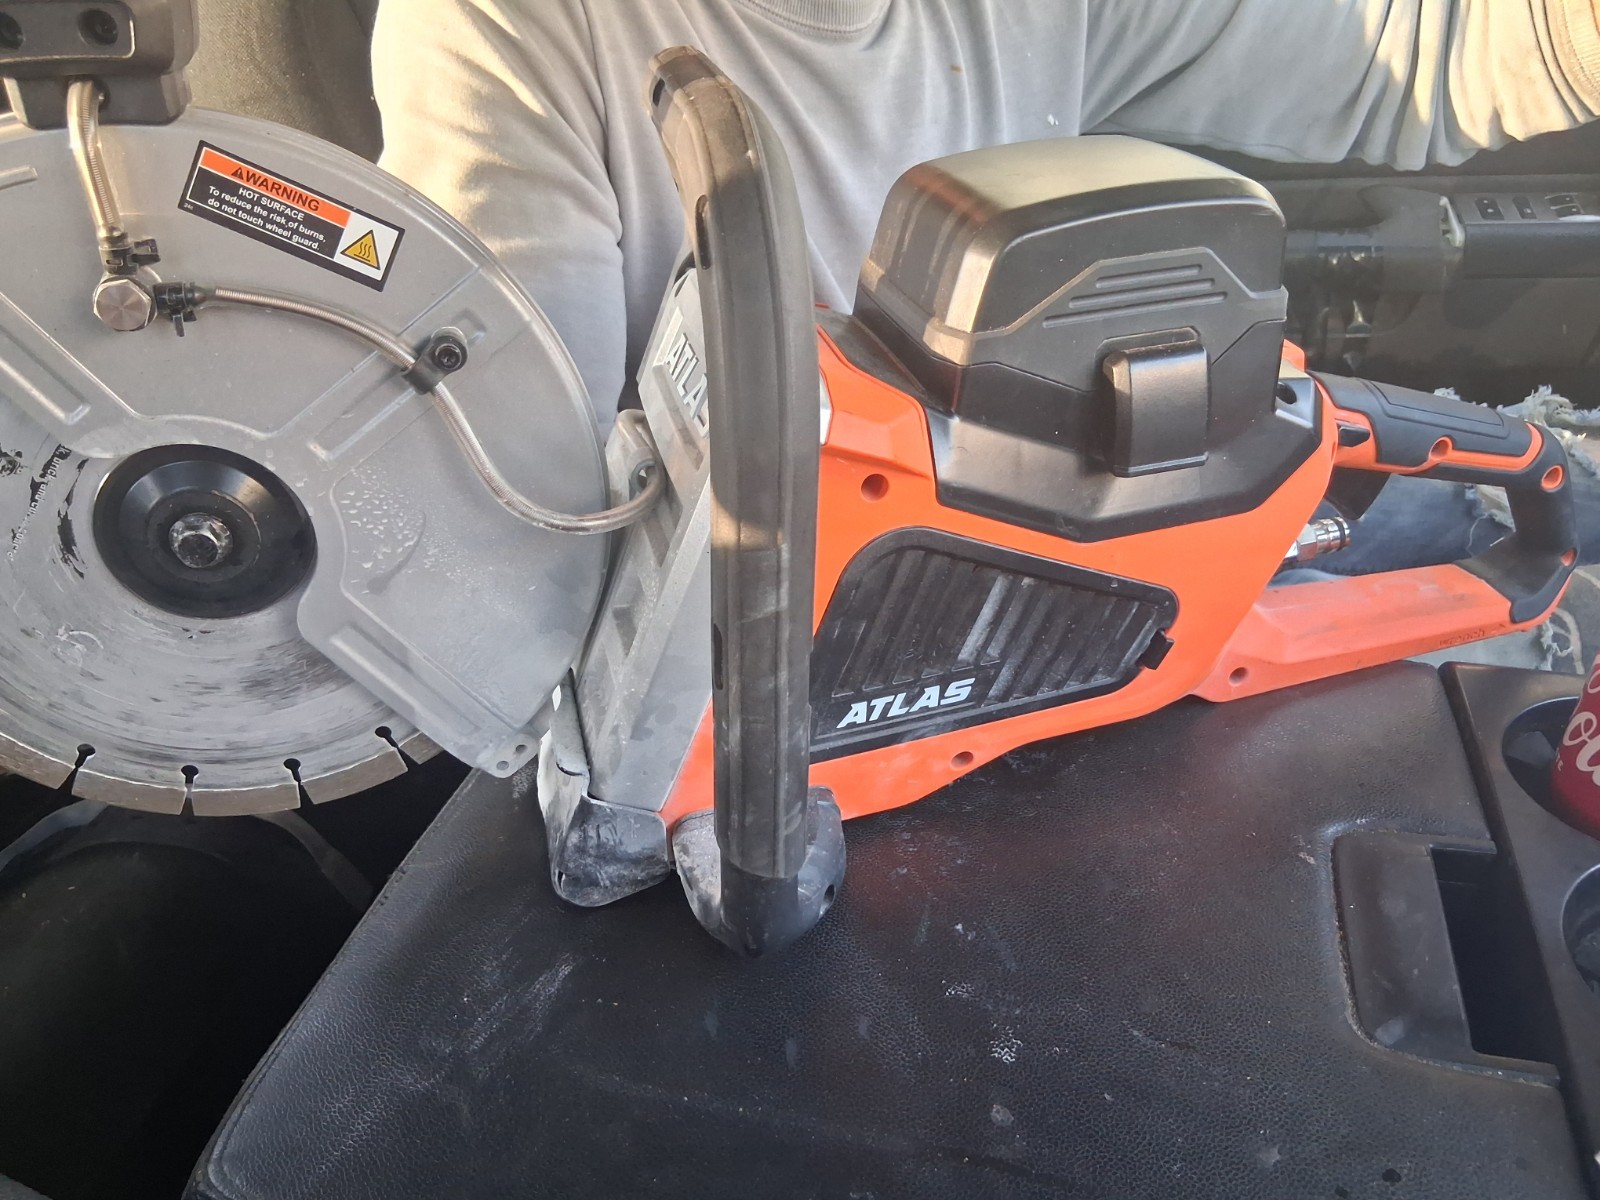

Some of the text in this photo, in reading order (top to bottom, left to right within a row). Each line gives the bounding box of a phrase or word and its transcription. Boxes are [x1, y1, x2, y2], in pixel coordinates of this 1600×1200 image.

[209, 185, 220, 196] To
[221, 193, 252, 210] reduce
[253, 205, 268, 217] the
[288, 221, 299, 230] of
[299, 224, 326, 243] burns,
[238, 187, 305, 221] HOT SURFACE
[246, 170, 320, 212] WARNING
[207, 198, 220, 208] do
[221, 204, 237, 215] not
[238, 210, 264, 227] touch
[265, 222, 292, 238] wheel
[292, 234, 320, 250] guard.
[836, 677, 976, 729] ATLAS
